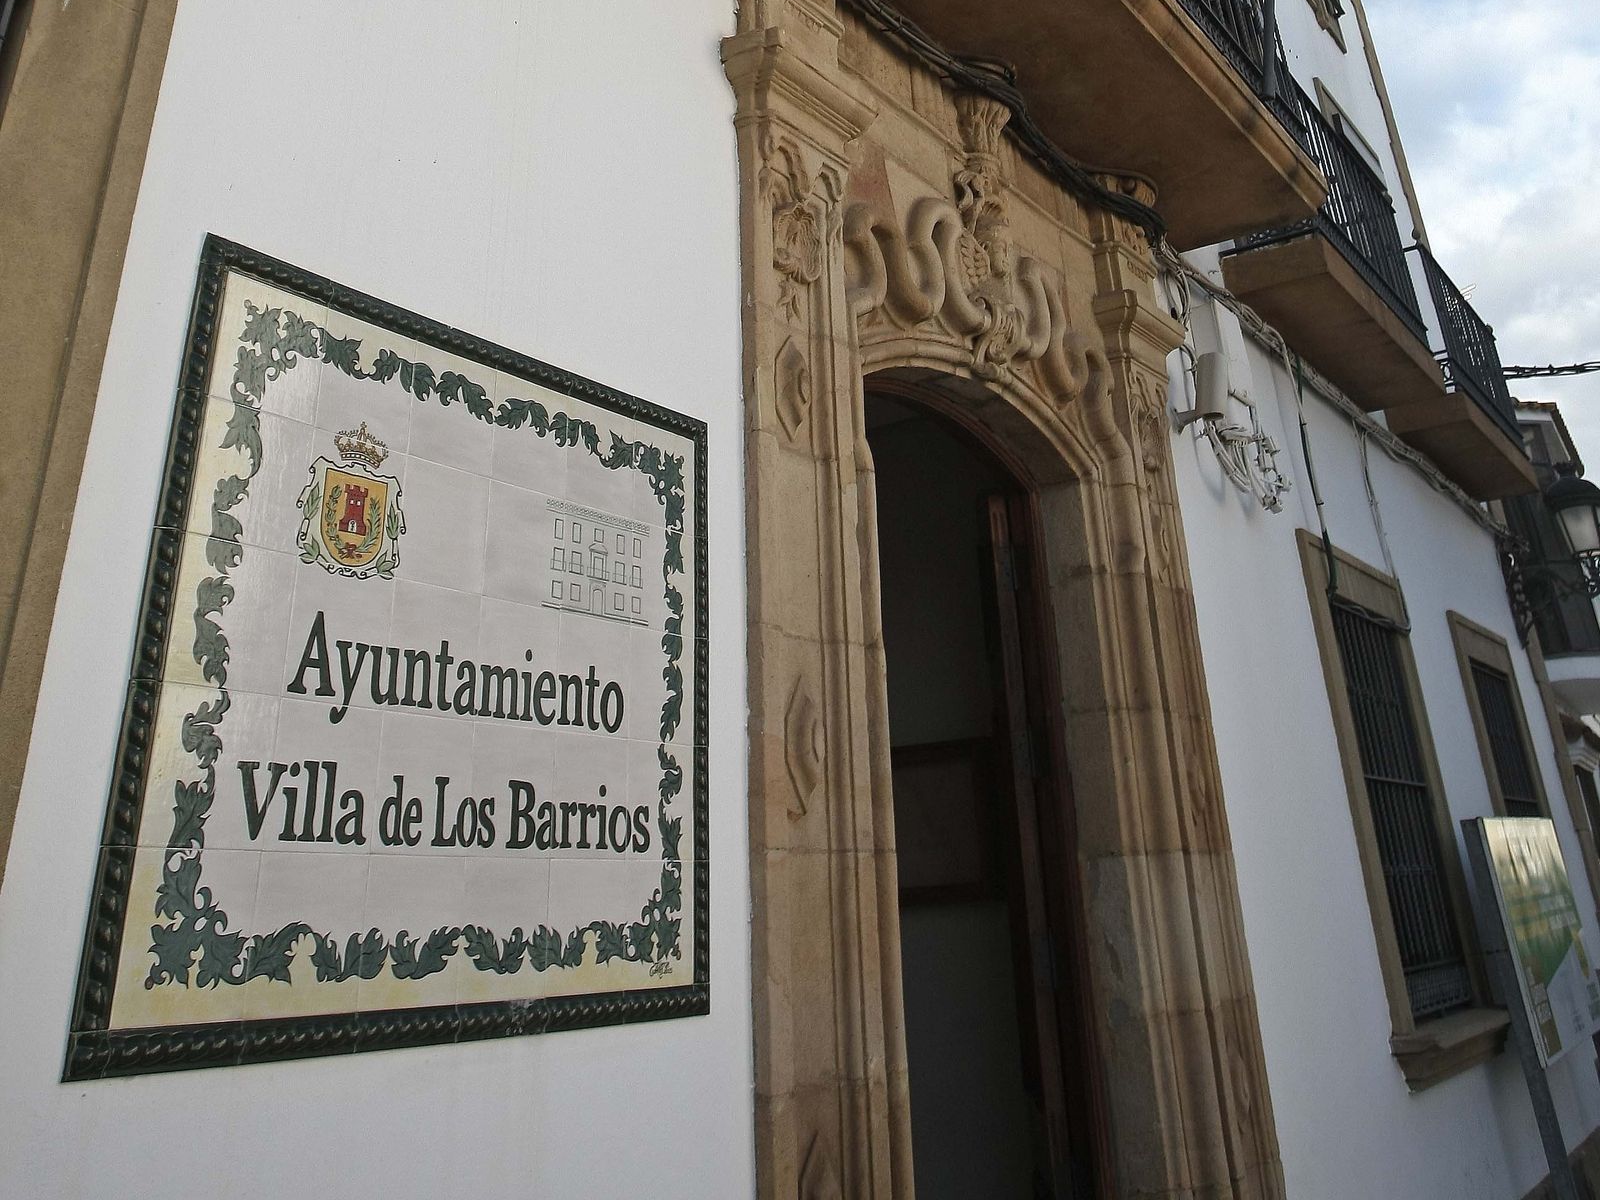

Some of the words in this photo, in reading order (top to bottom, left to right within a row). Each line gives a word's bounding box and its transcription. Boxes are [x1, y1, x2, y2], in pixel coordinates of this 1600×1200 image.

[286, 610, 625, 734] Ayuntamiento
[237, 761, 367, 846] Villa
[378, 774, 424, 848] de
[430, 776, 497, 850] Los
[504, 779, 651, 854] Barrios
